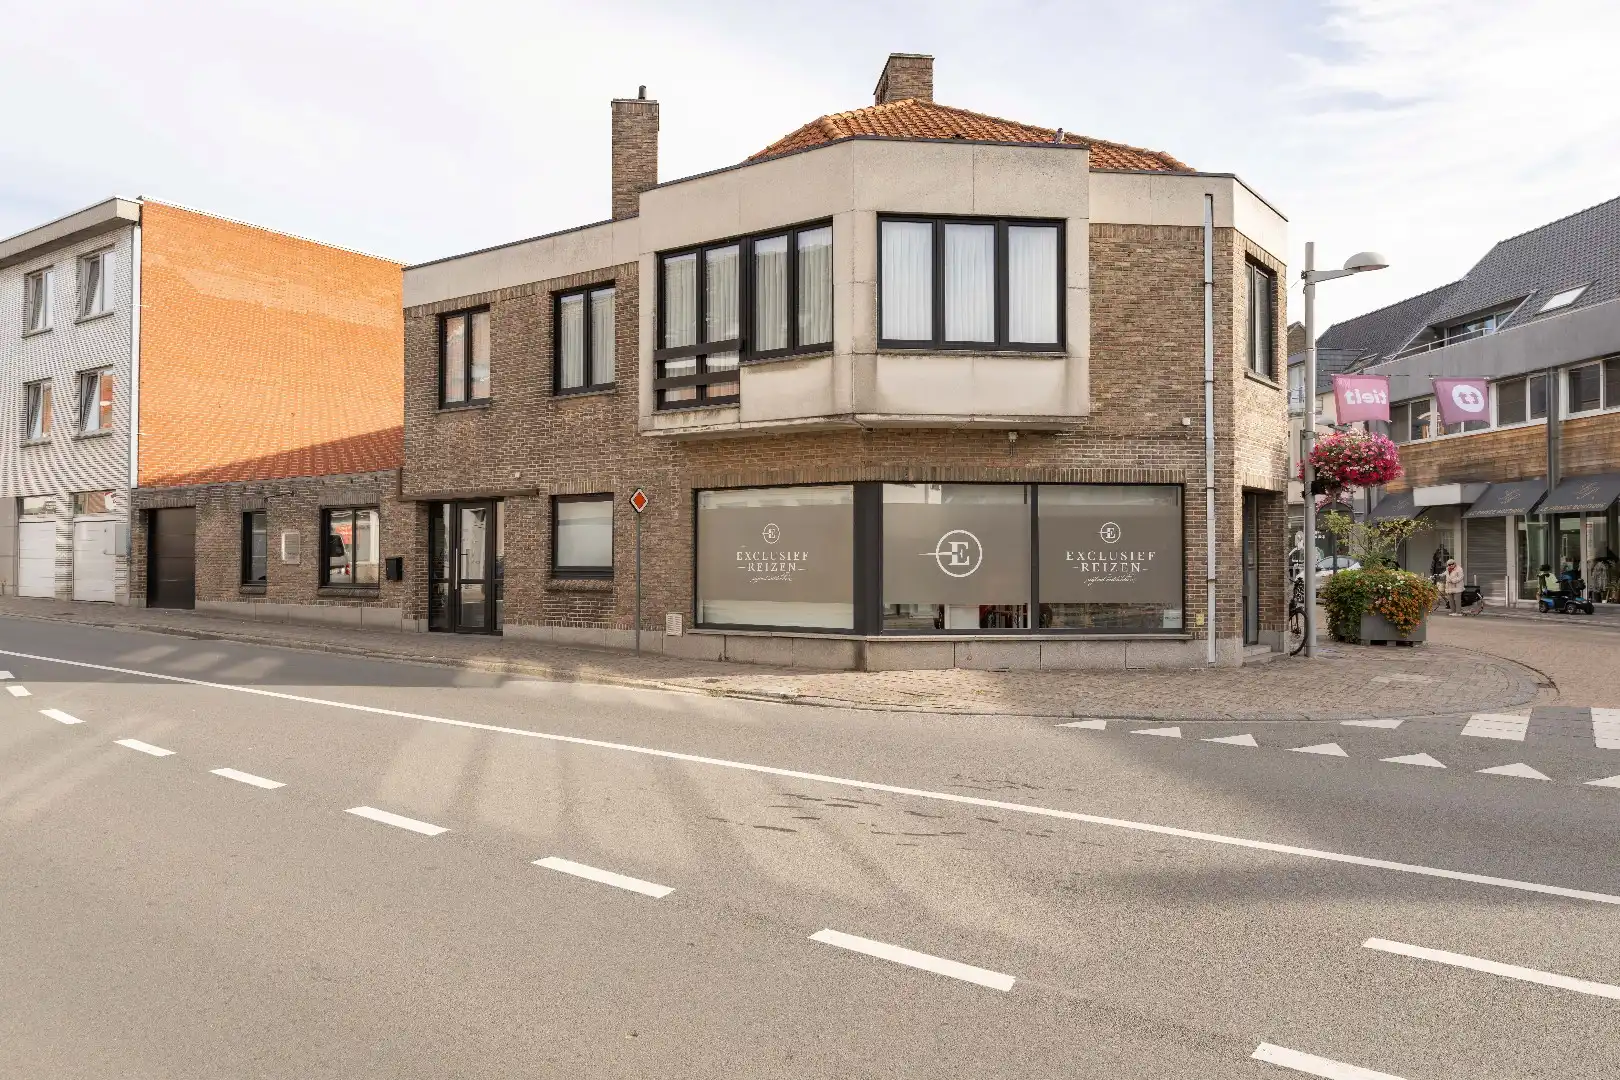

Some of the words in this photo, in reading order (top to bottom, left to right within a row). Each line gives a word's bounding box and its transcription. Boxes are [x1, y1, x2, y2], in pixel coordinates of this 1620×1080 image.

[736, 551, 809, 561] EXCLUSIEF
[1066, 551, 1156, 561] EXCLUSIEF
[747, 562, 797, 572] REIZEN
[1081, 562, 1141, 573] REIZEN
